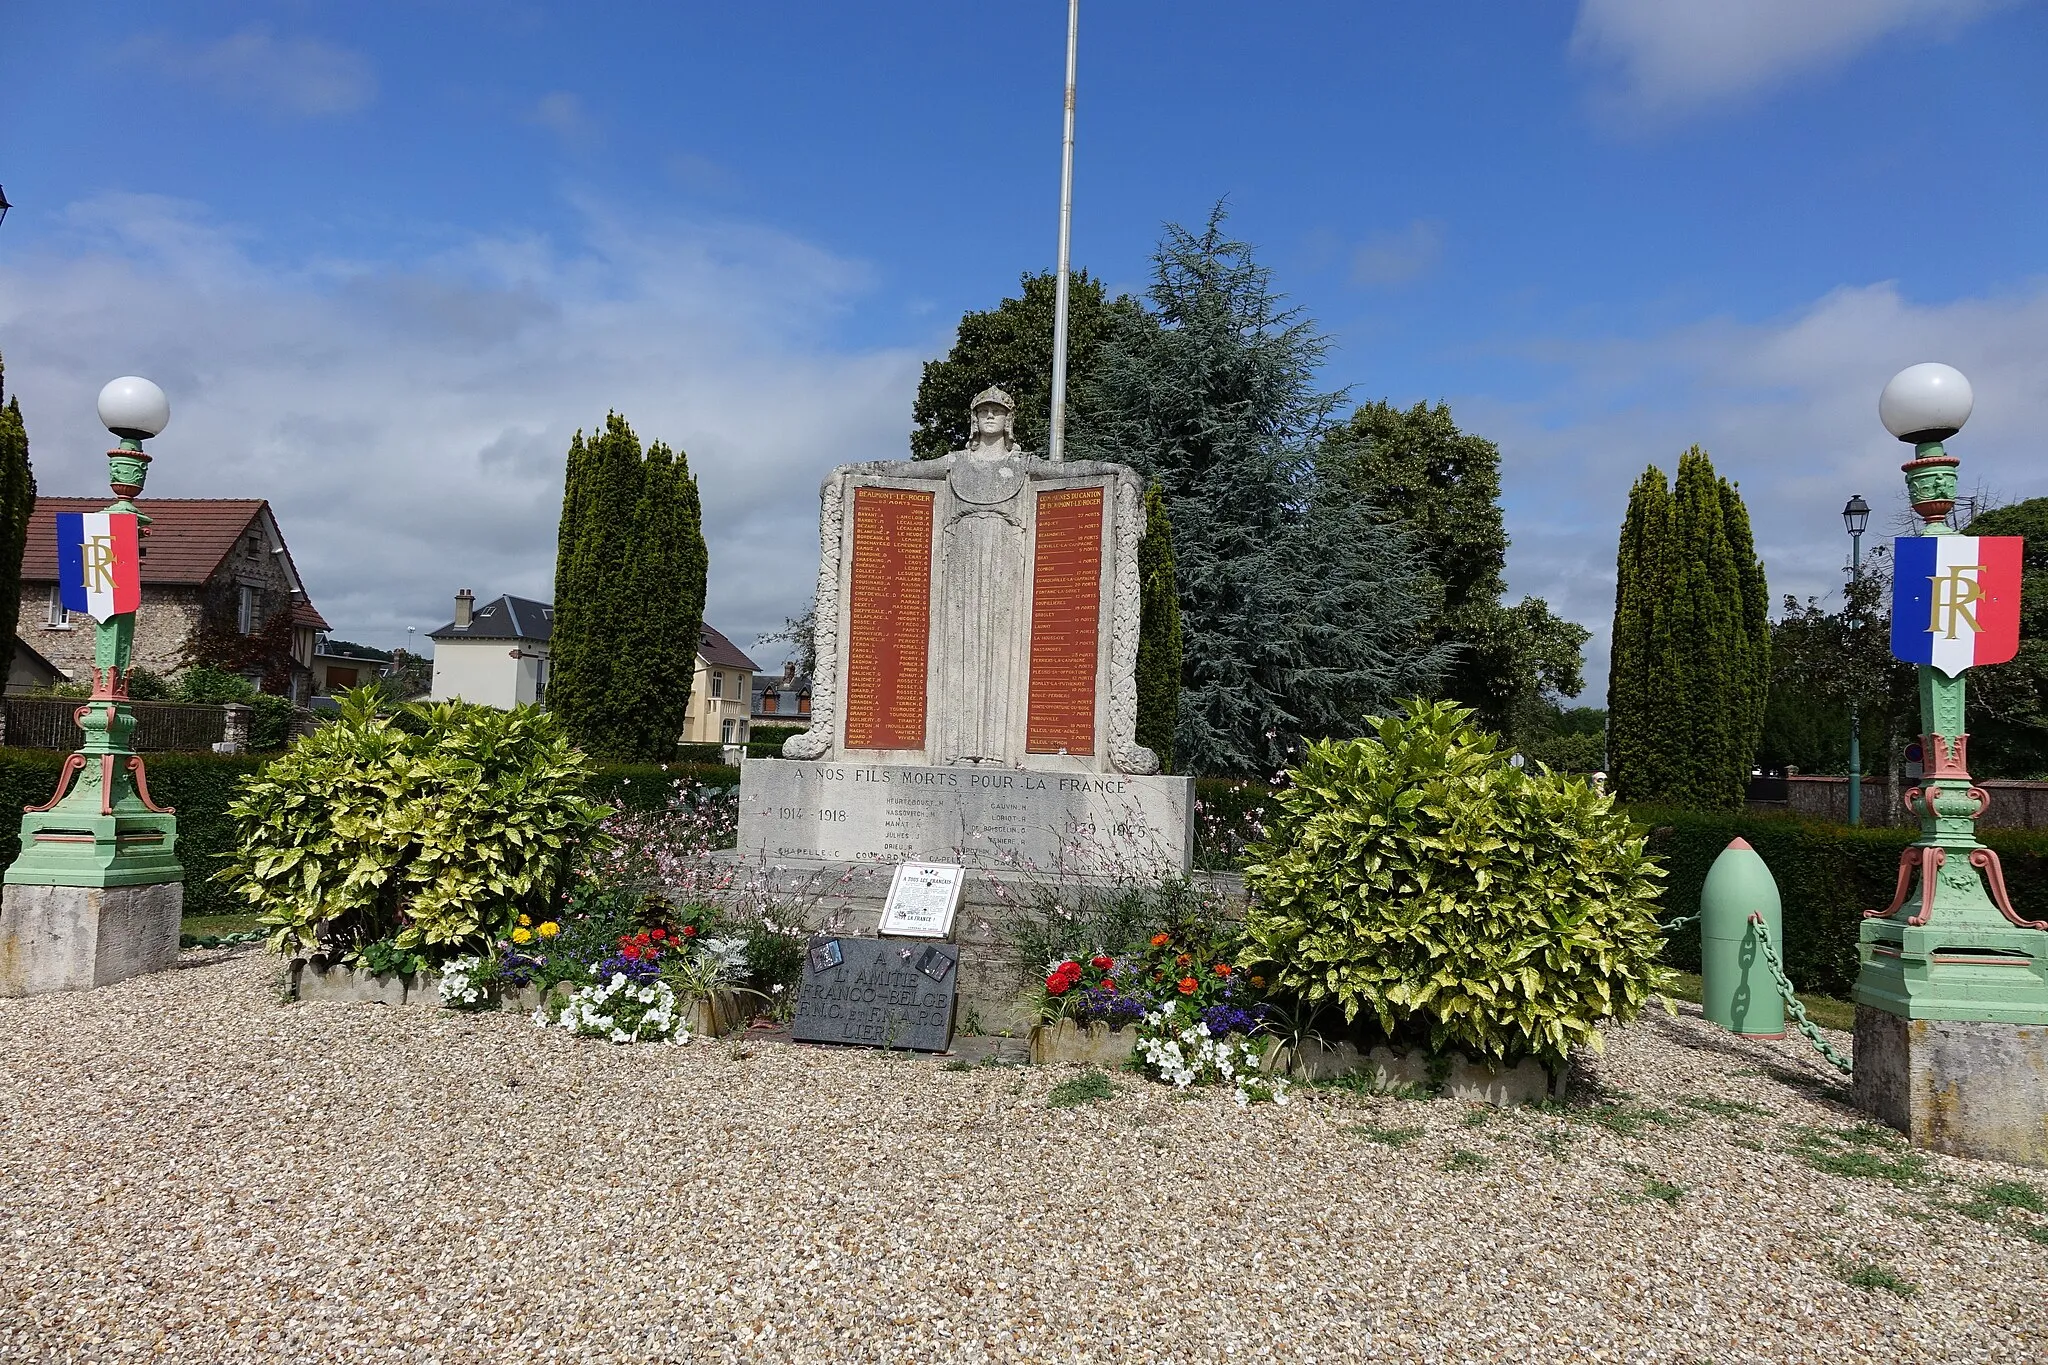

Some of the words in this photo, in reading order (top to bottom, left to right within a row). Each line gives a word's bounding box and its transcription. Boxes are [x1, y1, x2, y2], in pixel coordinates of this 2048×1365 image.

[794, 769, 804, 778] A
[816, 768, 844, 781] NOS
[855, 770, 890, 783] FILS
[902, 772, 957, 786] MORTS
[971, 775, 1013, 788] POUR
[1026, 778, 1046, 790] LA
[1060, 779, 1126, 794] FRANCE
[779, 808, 803, 819] 1914
[819, 809, 846, 822] 1918
[874, 952, 886, 965] A
[854, 970, 919, 988] AMITIE
[801, 985, 947, 1008] FRANCO-BELGE
